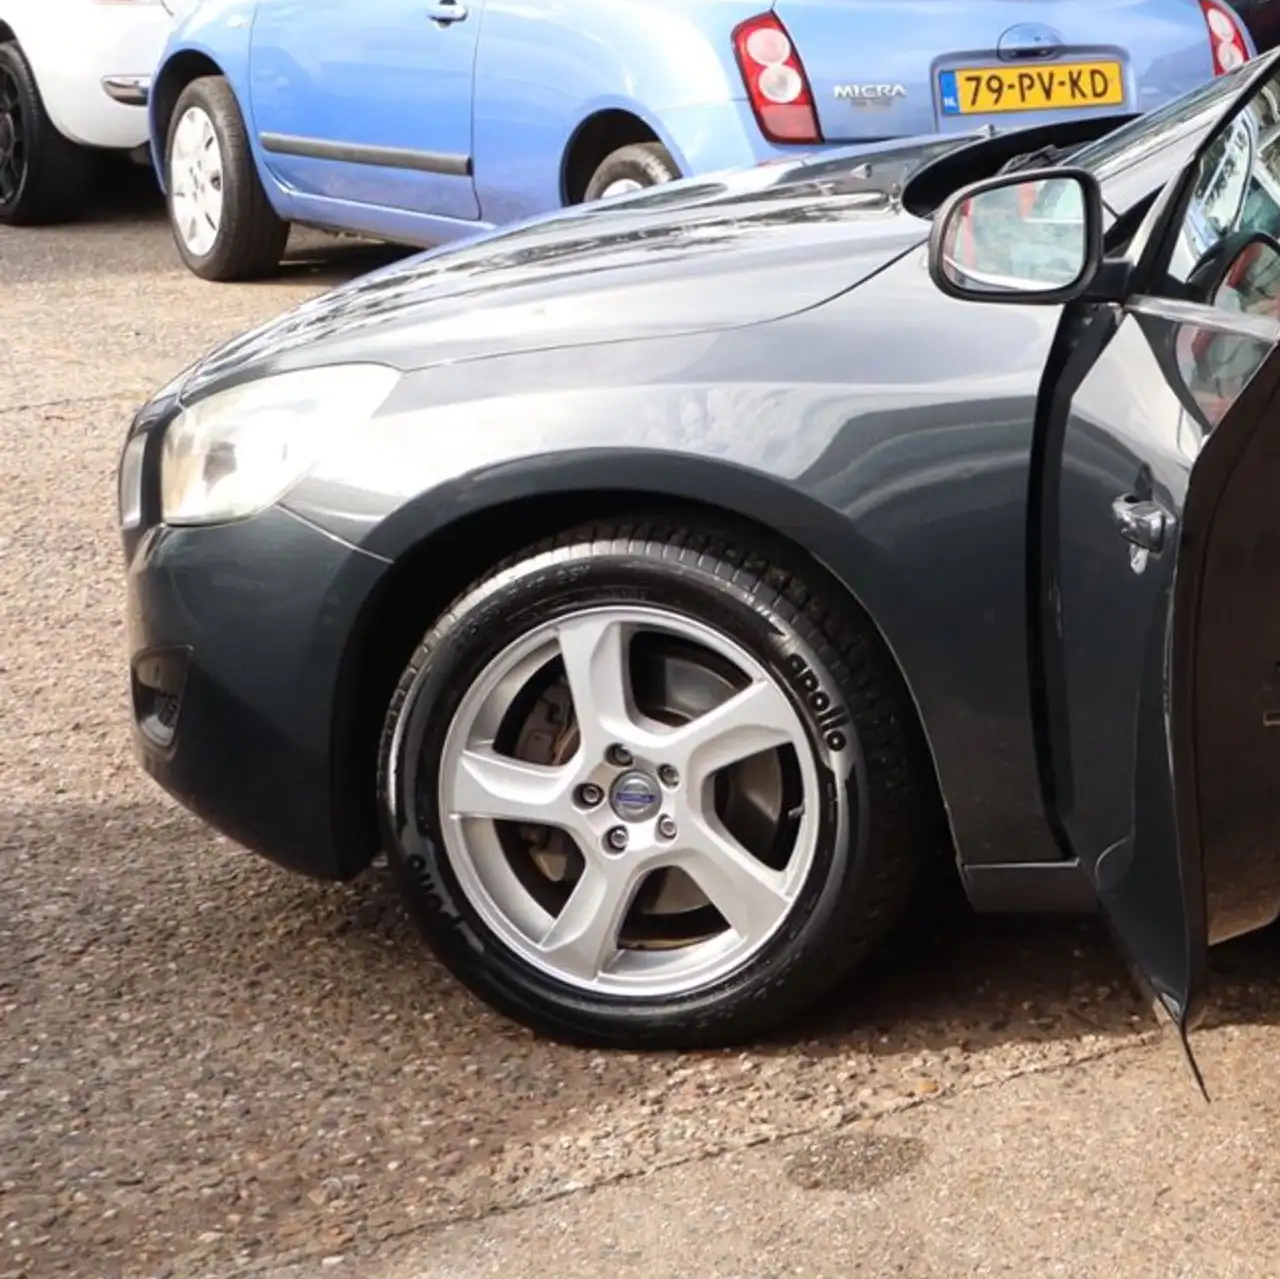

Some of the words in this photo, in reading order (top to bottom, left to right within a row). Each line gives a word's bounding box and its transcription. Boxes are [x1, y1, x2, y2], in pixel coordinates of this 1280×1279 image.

[833, 84, 909, 98] MICRA
[965, 69, 1109, 107] 79-PV-KD
[786, 652, 847, 753] apollo
